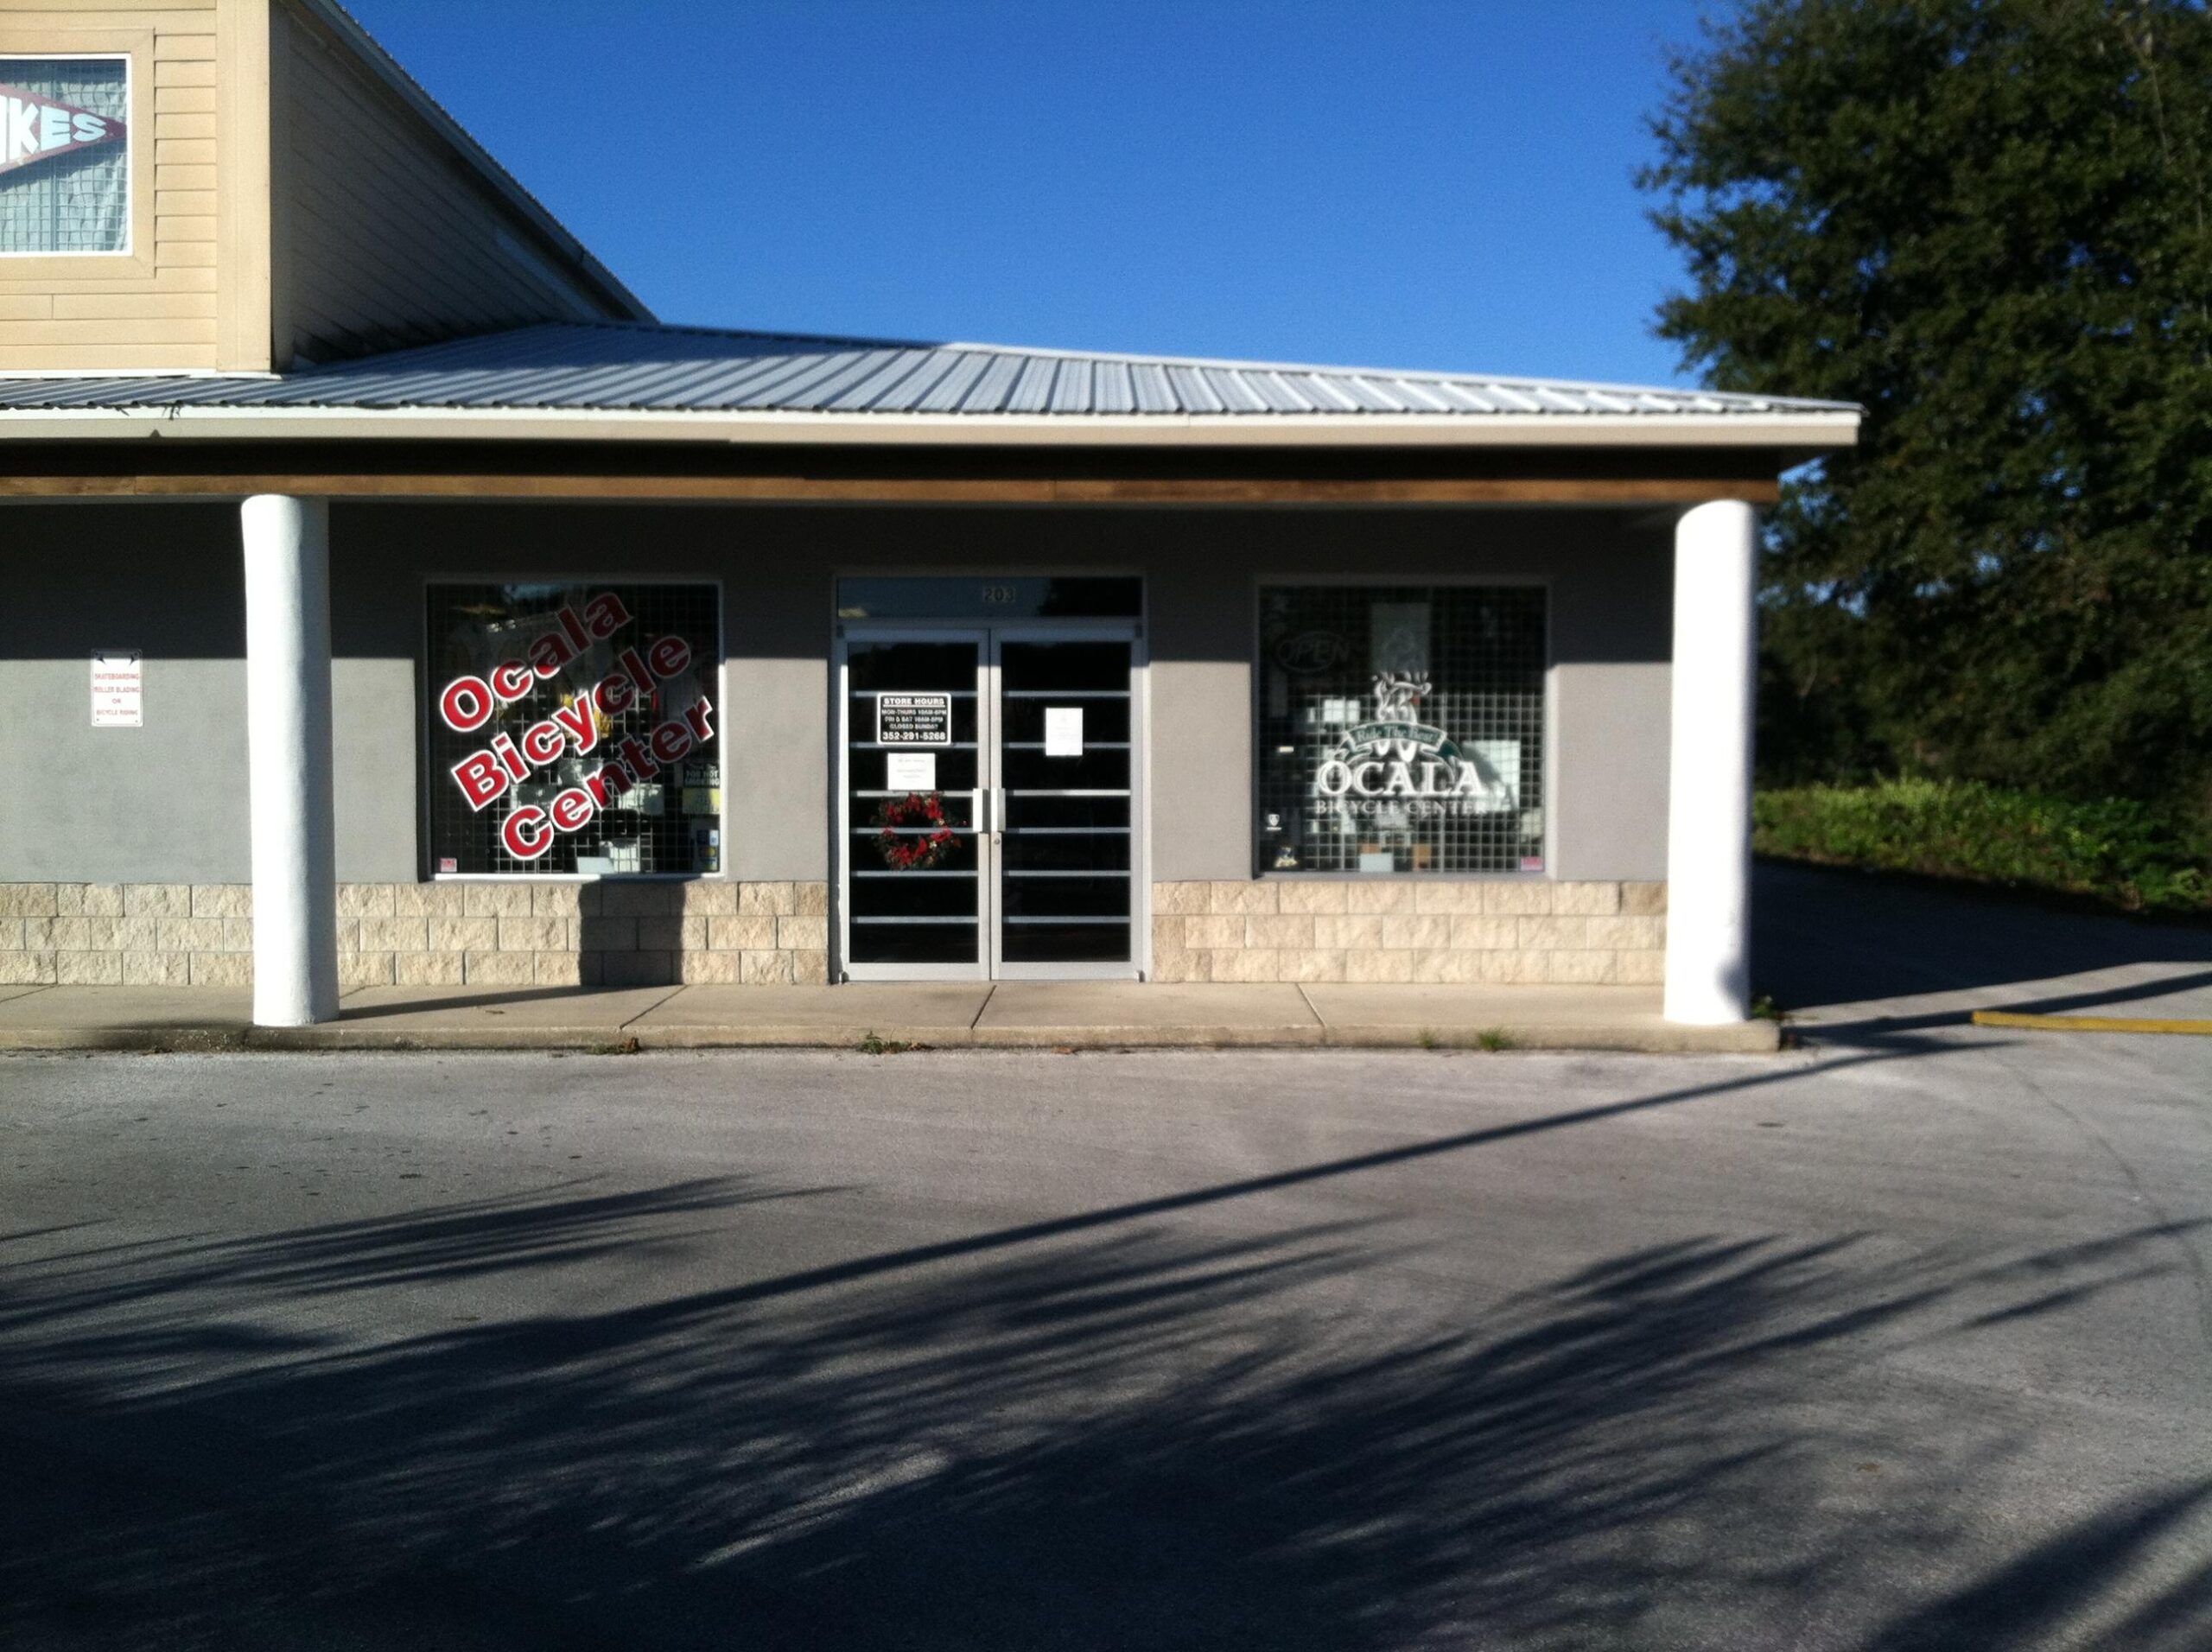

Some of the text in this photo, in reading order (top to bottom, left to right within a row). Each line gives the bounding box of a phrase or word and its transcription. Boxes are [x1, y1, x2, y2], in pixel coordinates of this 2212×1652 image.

[983, 587, 1014, 601] 203
[440, 591, 632, 733] Ocala
[451, 635, 691, 812] Bicycle
[882, 731, 946, 740] 352-291-5268
[1357, 728, 1382, 743] Ride
[1385, 725, 1407, 738] The
[501, 695, 715, 861] Center
[1317, 760, 1484, 796] OCALA
[1315, 799, 1486, 815] BICYCLE CENTER
